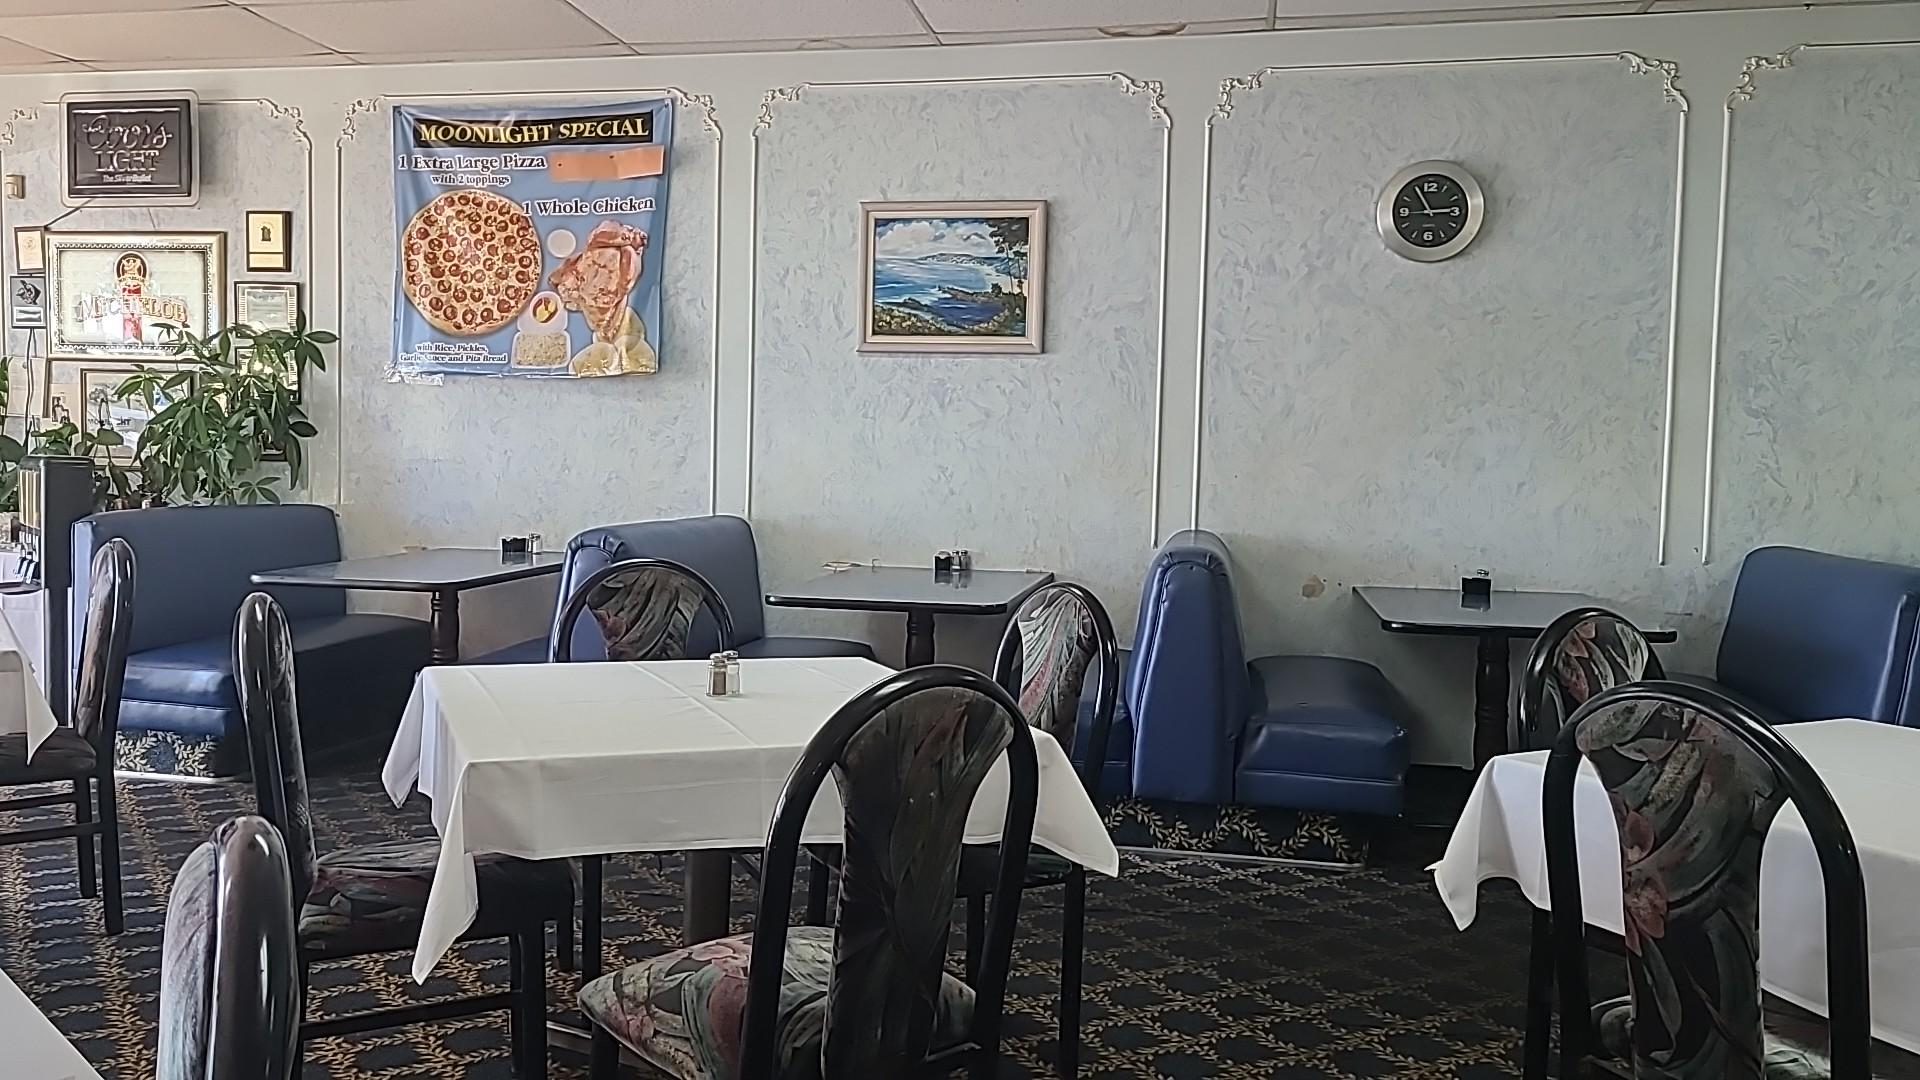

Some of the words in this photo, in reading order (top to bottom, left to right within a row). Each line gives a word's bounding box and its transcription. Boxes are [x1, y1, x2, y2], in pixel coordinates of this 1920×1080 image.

[82, 115, 173, 149] Coors
[420, 123, 554, 144] MOONLIGHT
[558, 118, 650, 140] SPECIAL
[95, 150, 160, 171] LIGHT
[399, 156, 407, 168] 1
[413, 156, 454, 169] Extra
[457, 156, 499, 172] Large
[502, 154, 546, 168] Pizza
[432, 174, 456, 184] with
[458, 175, 465, 184] 2
[466, 174, 510, 187] toppings
[1423, 183, 1438, 192] 12
[523, 203, 531, 215] 1
[537, 200, 589, 214] Whole
[592, 198, 654, 214] Chicken
[1400, 208, 1409, 217] 9
[1450, 207, 1460, 216] 3
[1423, 232, 1433, 241] 6
[416, 342, 433, 351] with
[434, 343, 455, 352] Rice,
[457, 343, 488, 353] Pickles,
[483, 353, 507, 362] Bread
